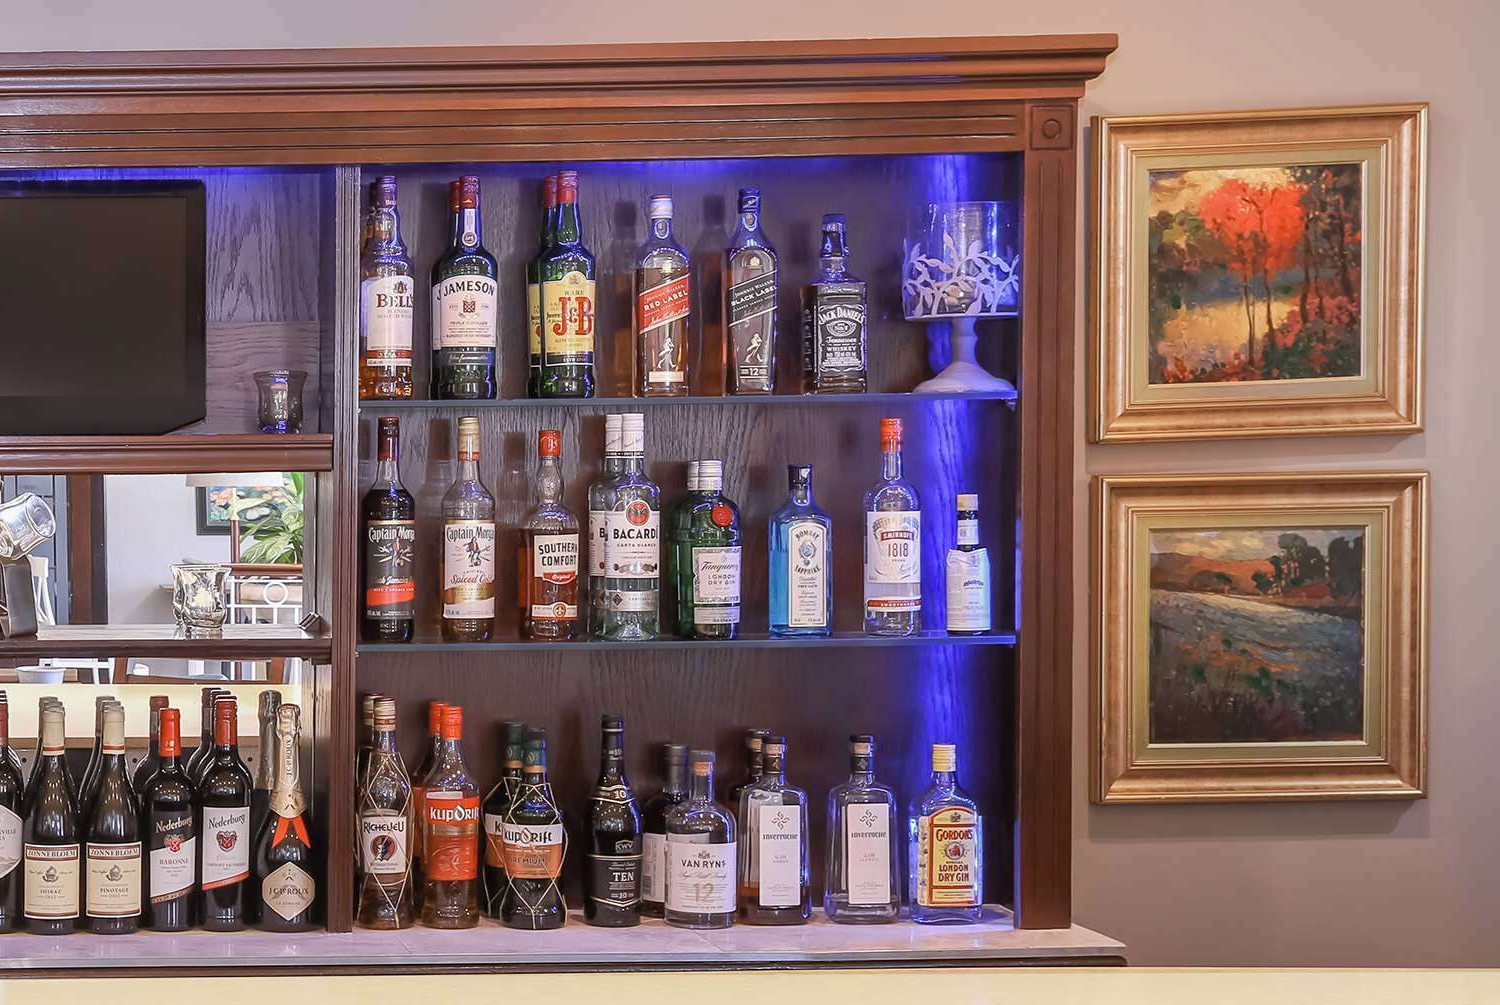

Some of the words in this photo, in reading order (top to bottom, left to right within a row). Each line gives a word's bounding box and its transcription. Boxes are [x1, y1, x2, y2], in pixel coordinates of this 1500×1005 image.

[443, 280, 495, 297] JAMESON
[643, 300, 661, 312] RED
[662, 289, 689, 304] LABEL
[730, 293, 754, 307] BLACK
[754, 285, 779, 299] LABEL
[552, 296, 594, 336] J&B
[819, 309, 837, 325] JACK
[749, 367, 759, 376] 12
[368, 527, 398, 543] Captain
[446, 527, 474, 543] Captain
[538, 541, 578, 555] SOUTHERN
[887, 542, 909, 558] 1818
[541, 555, 577, 567] COMFORT
[450, 574, 479, 585] Spiced
[613, 789, 626, 800] 10
[155, 815, 193, 834] Nederburg
[208, 813, 246, 831] Nederburg
[935, 828, 973, 842] GORDON'S
[28, 849, 76, 858] ZONNEBLOEM
[90, 848, 138, 857] ZONNEBLOEM
[681, 860, 701, 869] VAN
[939, 863, 969, 873] LONDON
[612, 871, 634, 882] TEN
[938, 873, 955, 883] DRY
[956, 872, 970, 882] GIN
[290, 886, 310, 896] ROUX
[693, 883, 714, 902] 12
